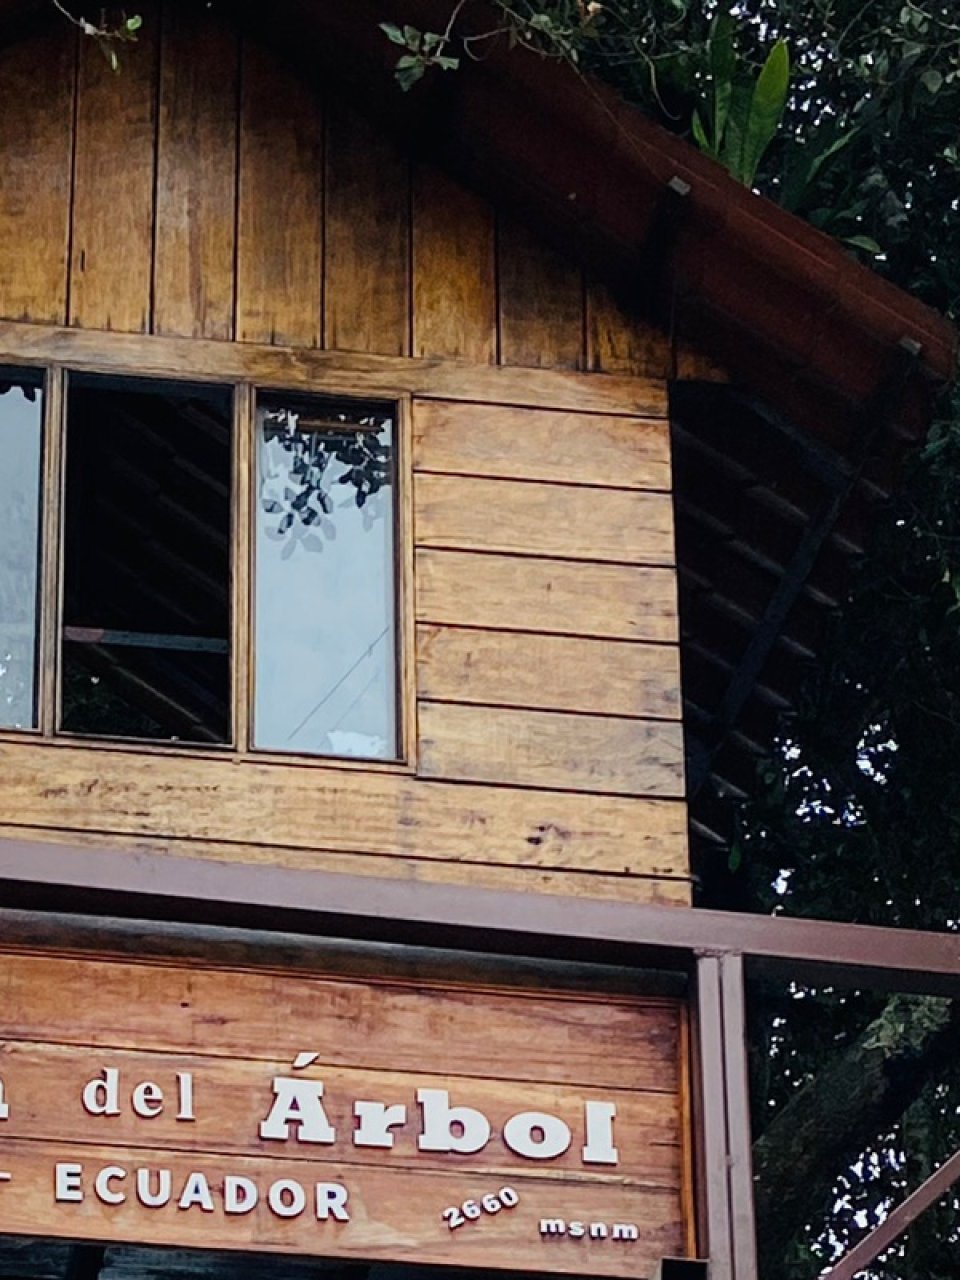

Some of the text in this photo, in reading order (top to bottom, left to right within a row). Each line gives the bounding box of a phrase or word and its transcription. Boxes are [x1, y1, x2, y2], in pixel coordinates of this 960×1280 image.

[82, 1067, 196, 1121] del
[260, 1052, 619, 1164] Árbol
[55, 1163, 350, 1221] ECUADOR
[442, 1187, 640, 1241] 2660 msnm
